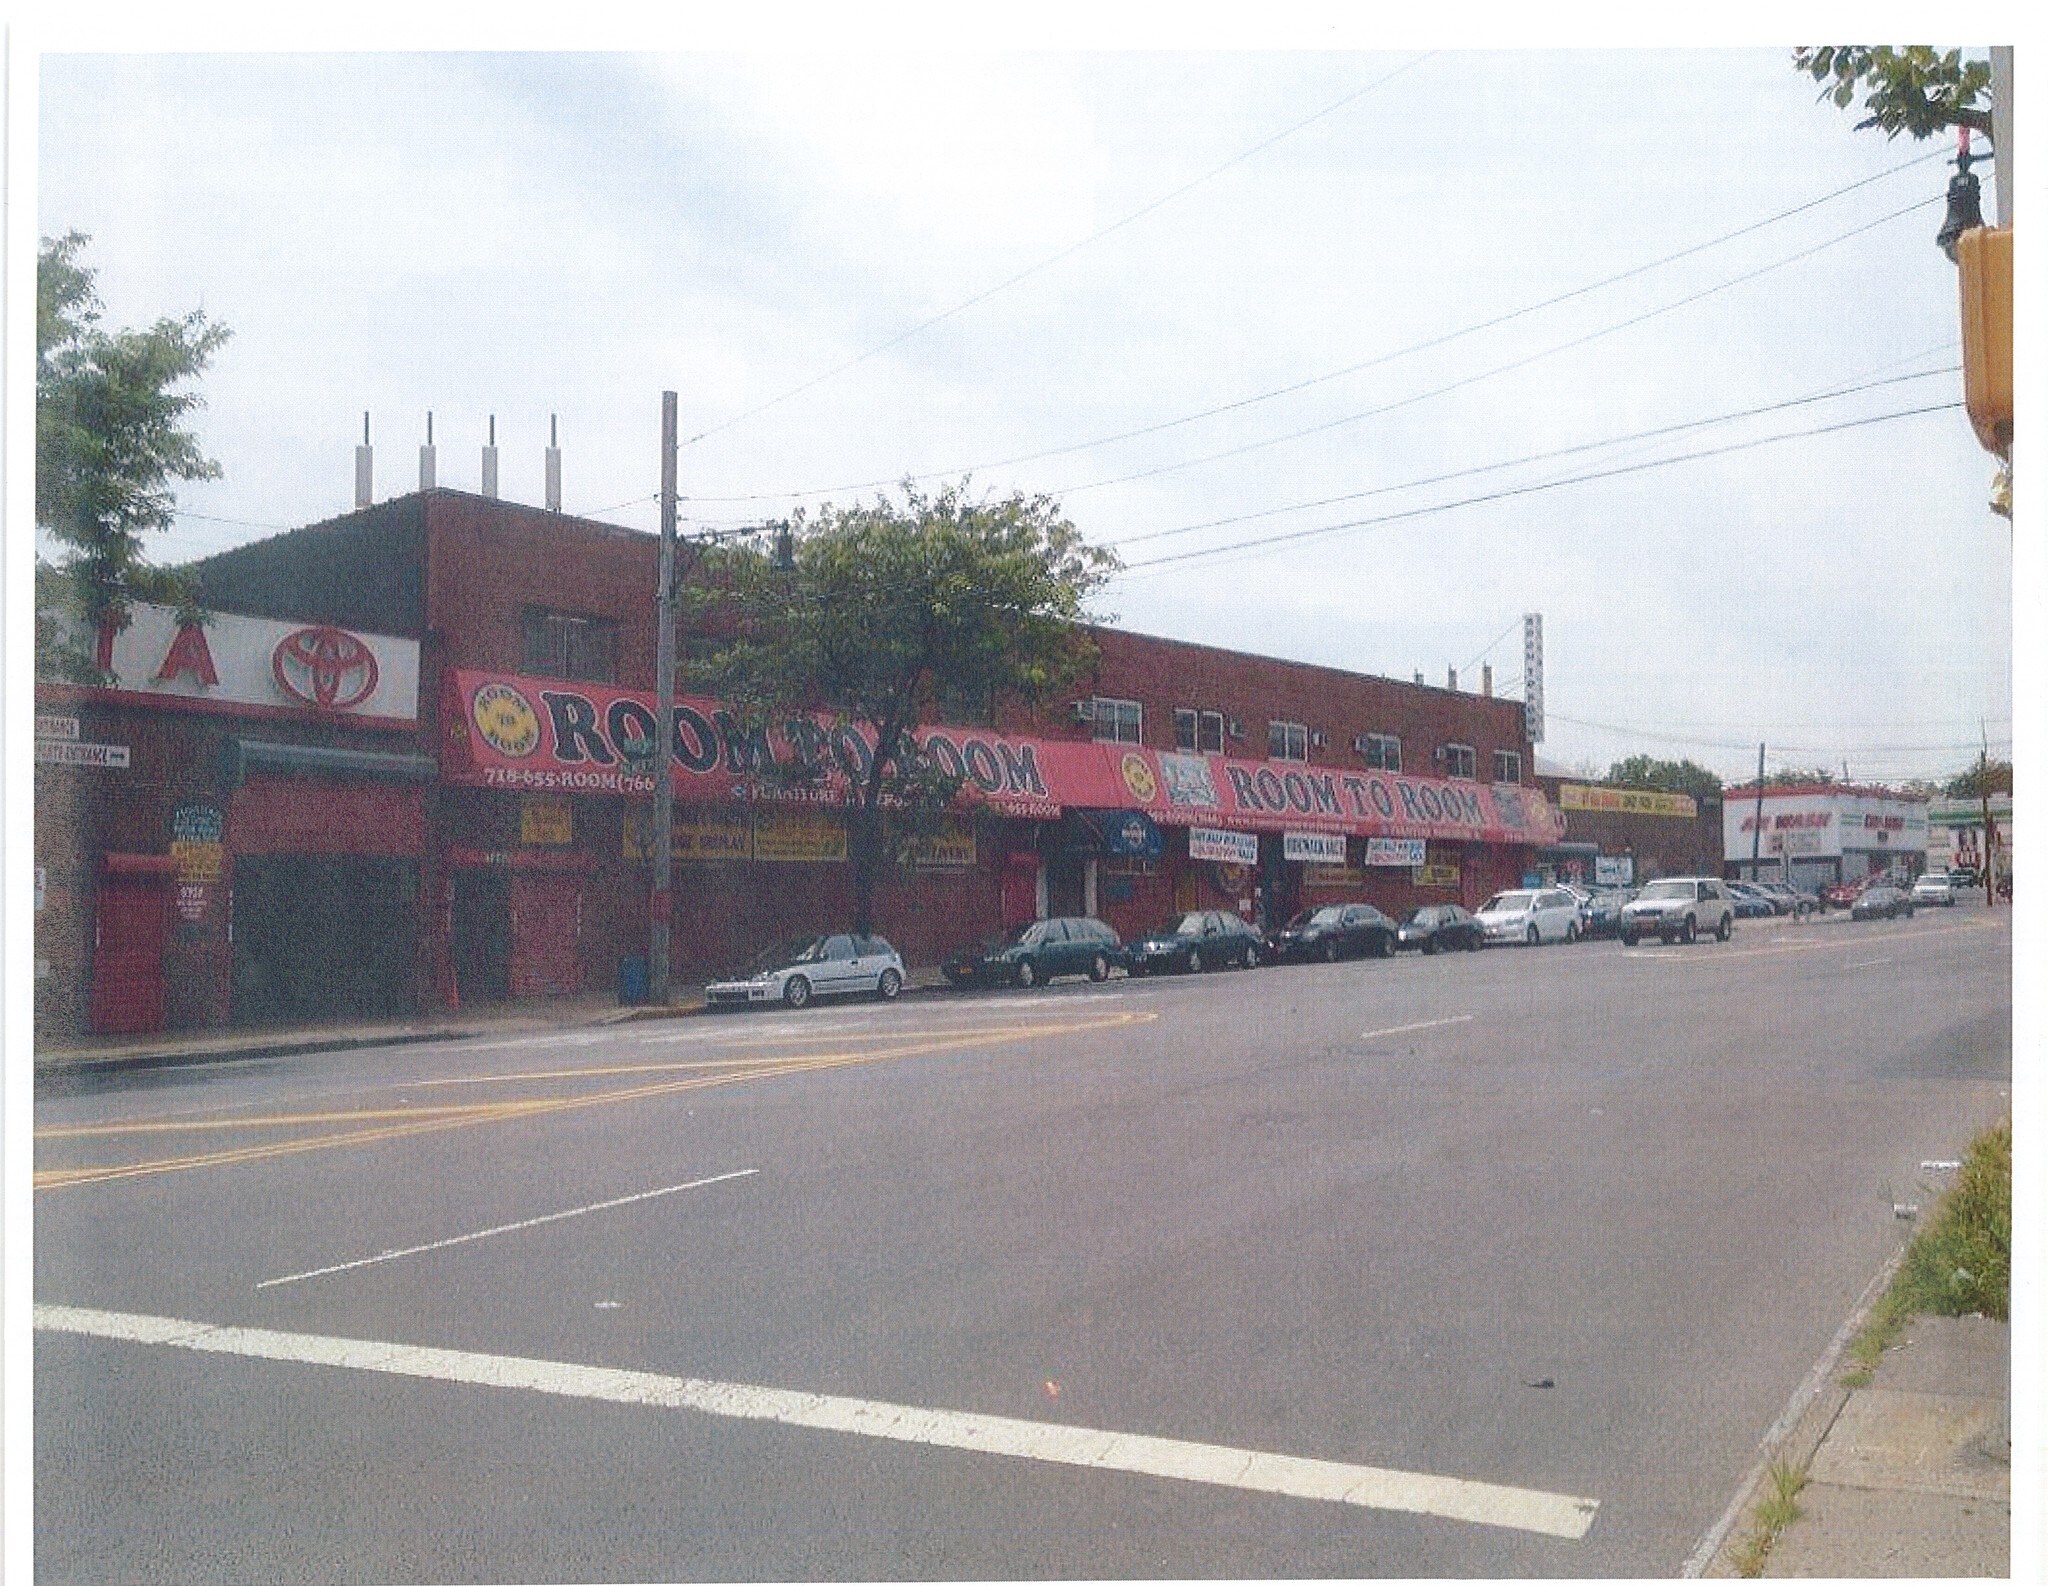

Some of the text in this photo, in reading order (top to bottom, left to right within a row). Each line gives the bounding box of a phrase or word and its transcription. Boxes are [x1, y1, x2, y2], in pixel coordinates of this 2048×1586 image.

[539, 690, 777, 781] ROOM
[1224, 765, 1345, 815] ROOM
[1342, 775, 1394, 820] TO
[1395, 779, 1486, 828] ROOM
